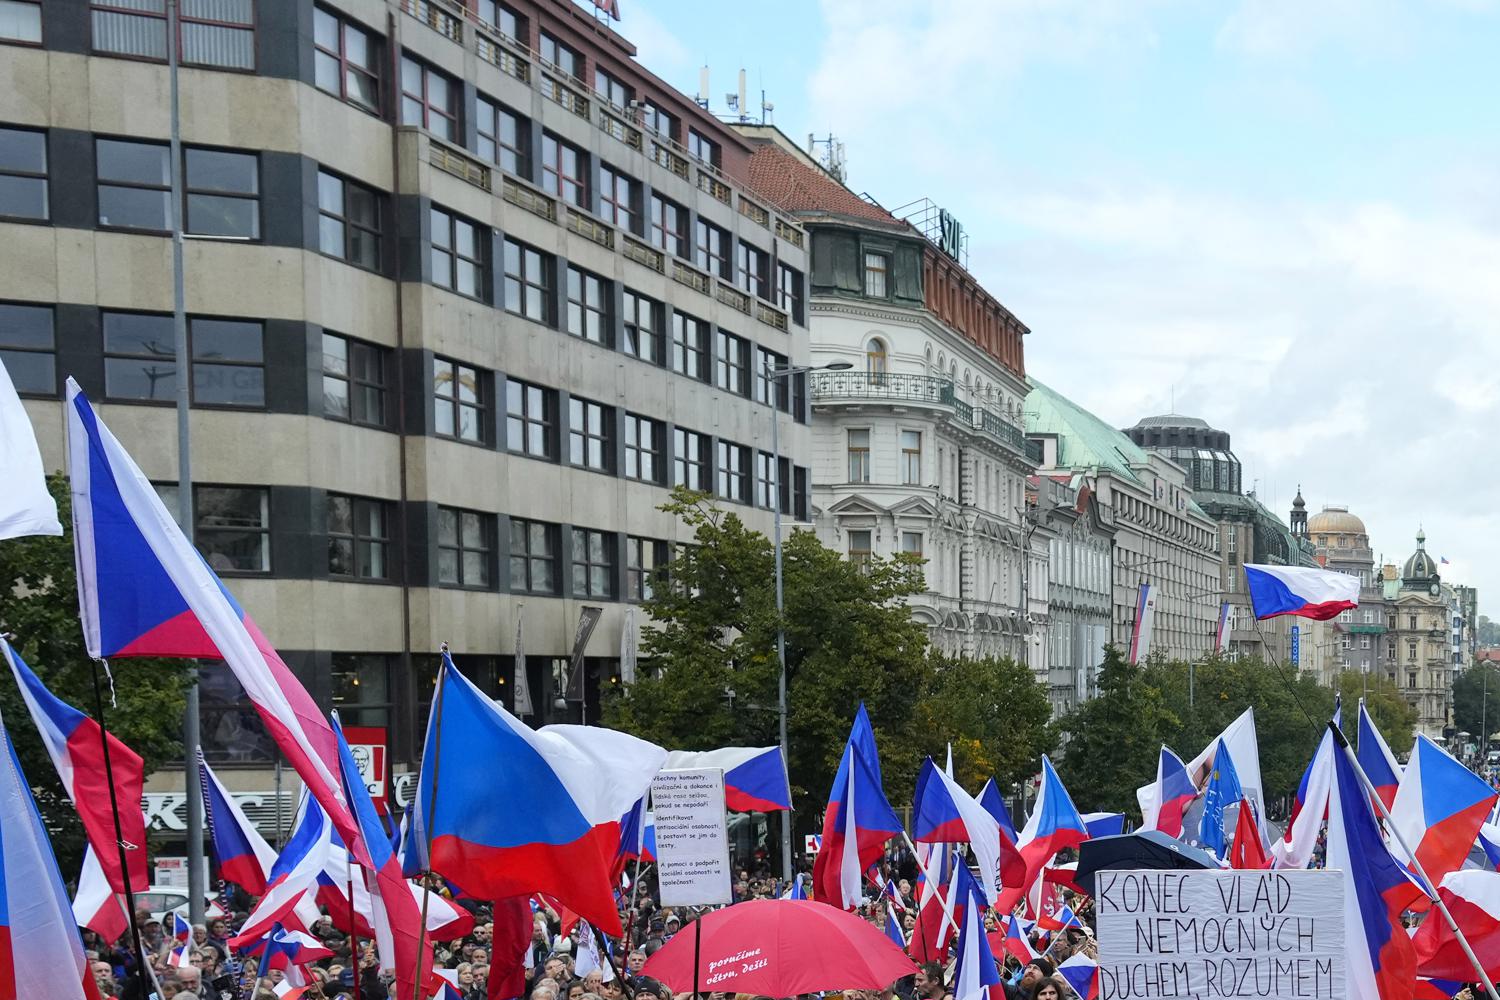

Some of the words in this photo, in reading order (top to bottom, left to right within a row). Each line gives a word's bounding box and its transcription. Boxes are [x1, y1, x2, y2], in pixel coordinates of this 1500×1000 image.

[1099, 873, 1190, 914] KONEC
[1217, 873, 1292, 914] VLÁD
[1136, 912, 1314, 954] NEMOCNÝCH
[708, 947, 762, 973] poručíme
[1205, 958, 1333, 999] ROZUMEM
